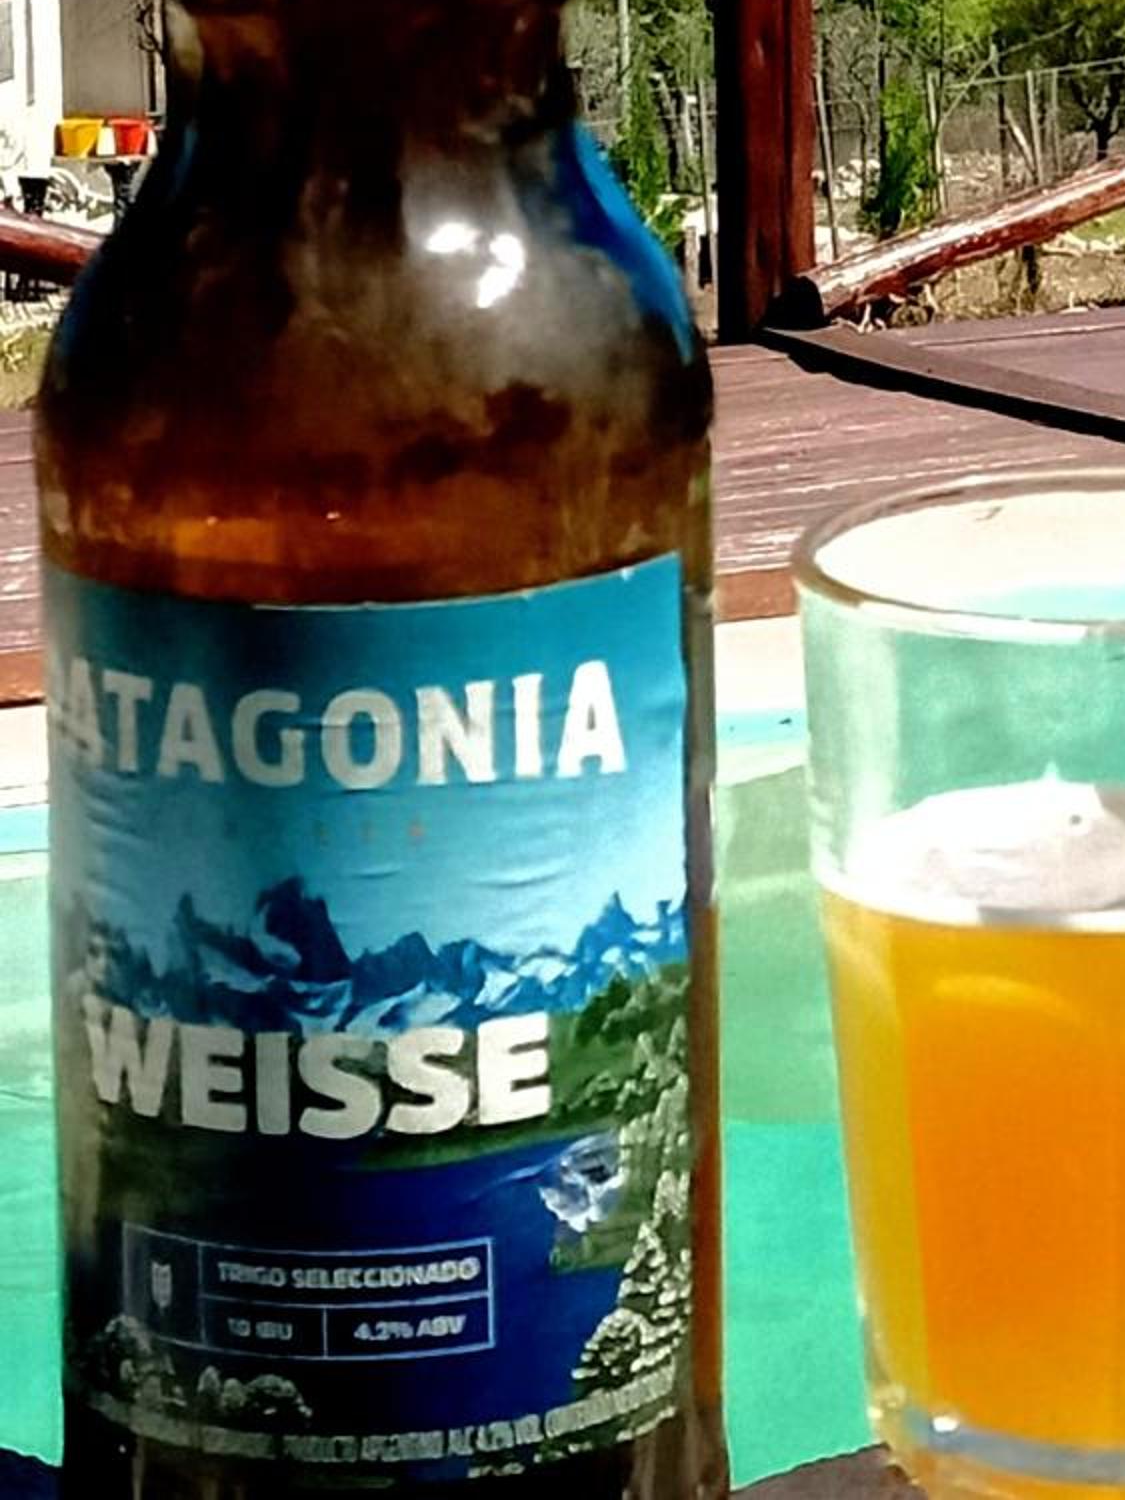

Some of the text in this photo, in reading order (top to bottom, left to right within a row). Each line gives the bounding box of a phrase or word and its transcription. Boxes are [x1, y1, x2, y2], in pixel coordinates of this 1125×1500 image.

[54, 657, 627, 790] ATAGONIA
[83, 1000, 552, 1140] WEISSE
[216, 1255, 482, 1290] TRIGO SELECCIONADO
